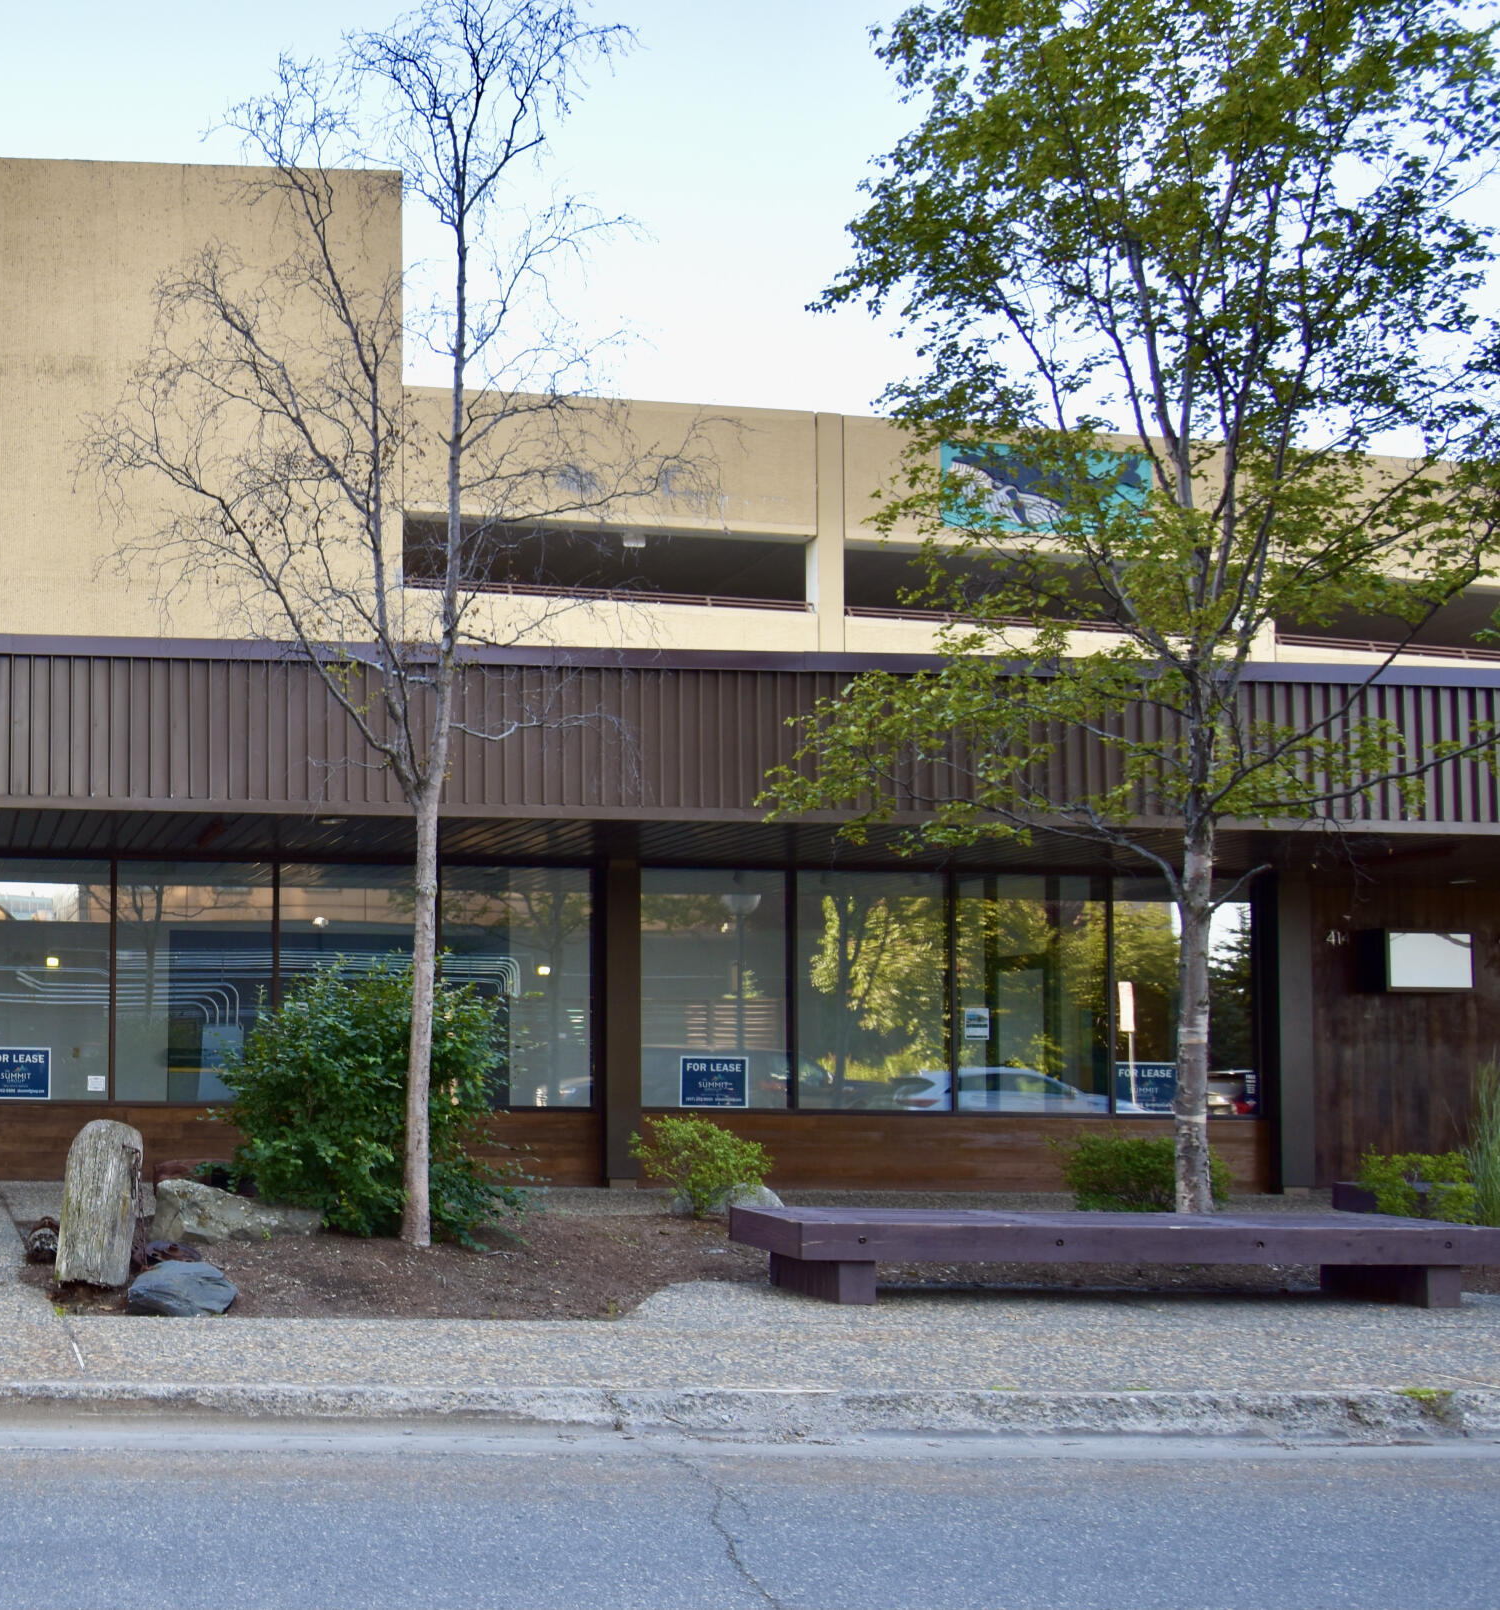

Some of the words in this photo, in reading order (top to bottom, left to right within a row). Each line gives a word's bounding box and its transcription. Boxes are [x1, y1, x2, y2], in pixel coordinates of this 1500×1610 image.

[12, 1054, 45, 1063] LEASE
[686, 1063, 707, 1072] FOR
[710, 1063, 742, 1072] LEASE
[0, 1072, 31, 1080] SUMMIT
[1141, 1069, 1173, 1078] LEASE
